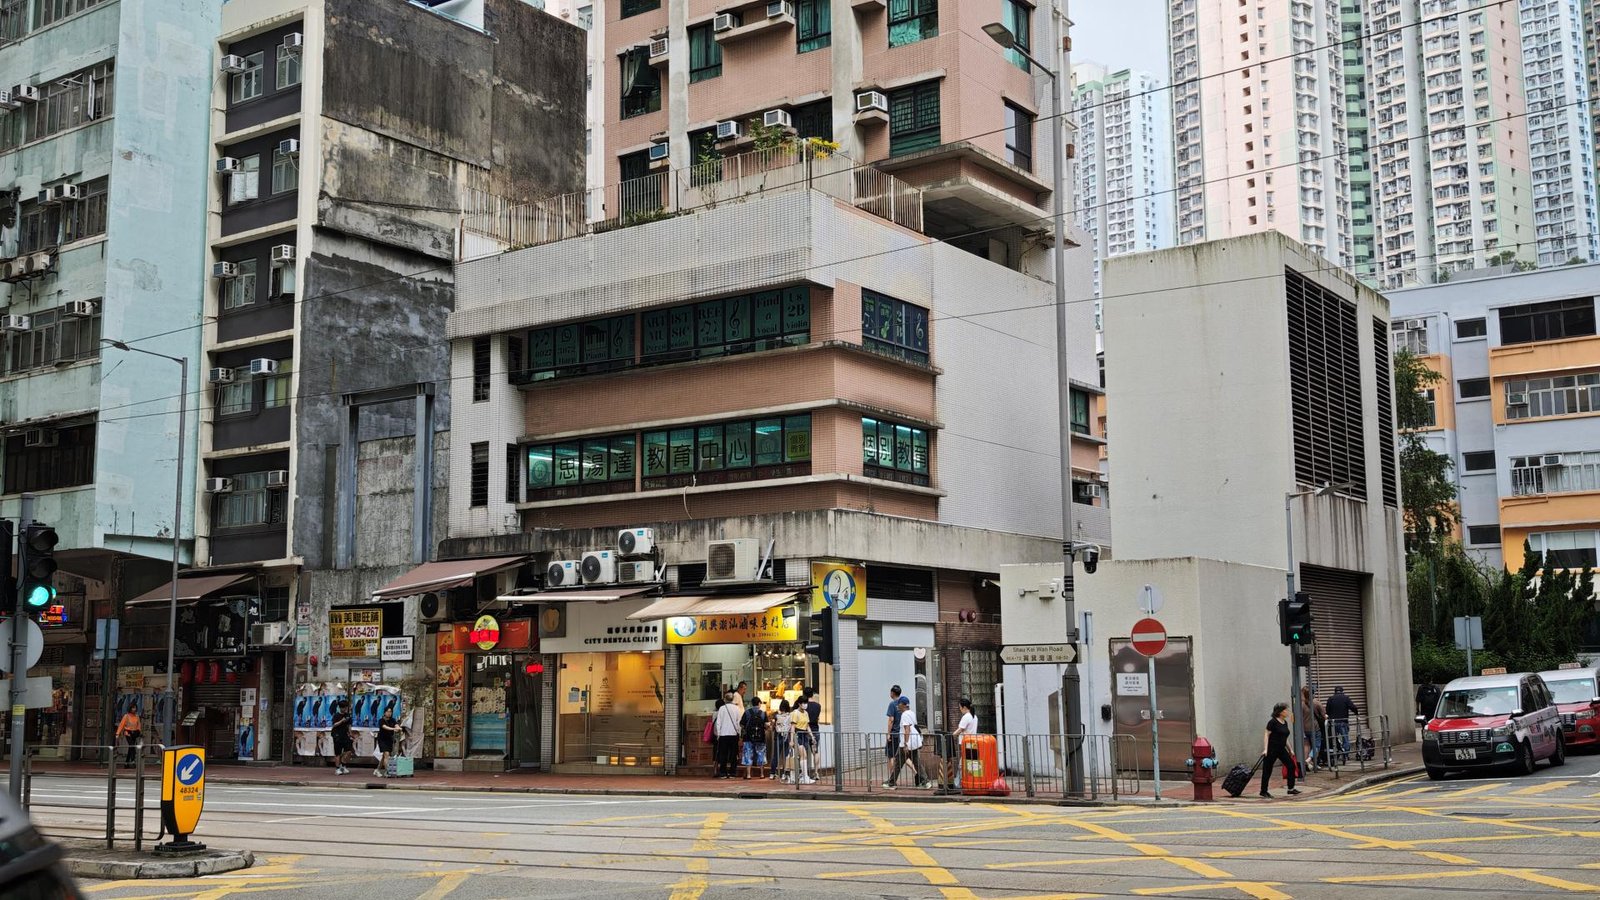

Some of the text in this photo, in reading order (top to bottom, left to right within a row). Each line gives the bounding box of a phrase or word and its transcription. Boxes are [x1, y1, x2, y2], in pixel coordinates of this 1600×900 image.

[863, 434, 927, 469] 個別教育
[345, 626, 379, 638] 9036-4267
[584, 635, 659, 645] CITY DENTAL CLINIC
